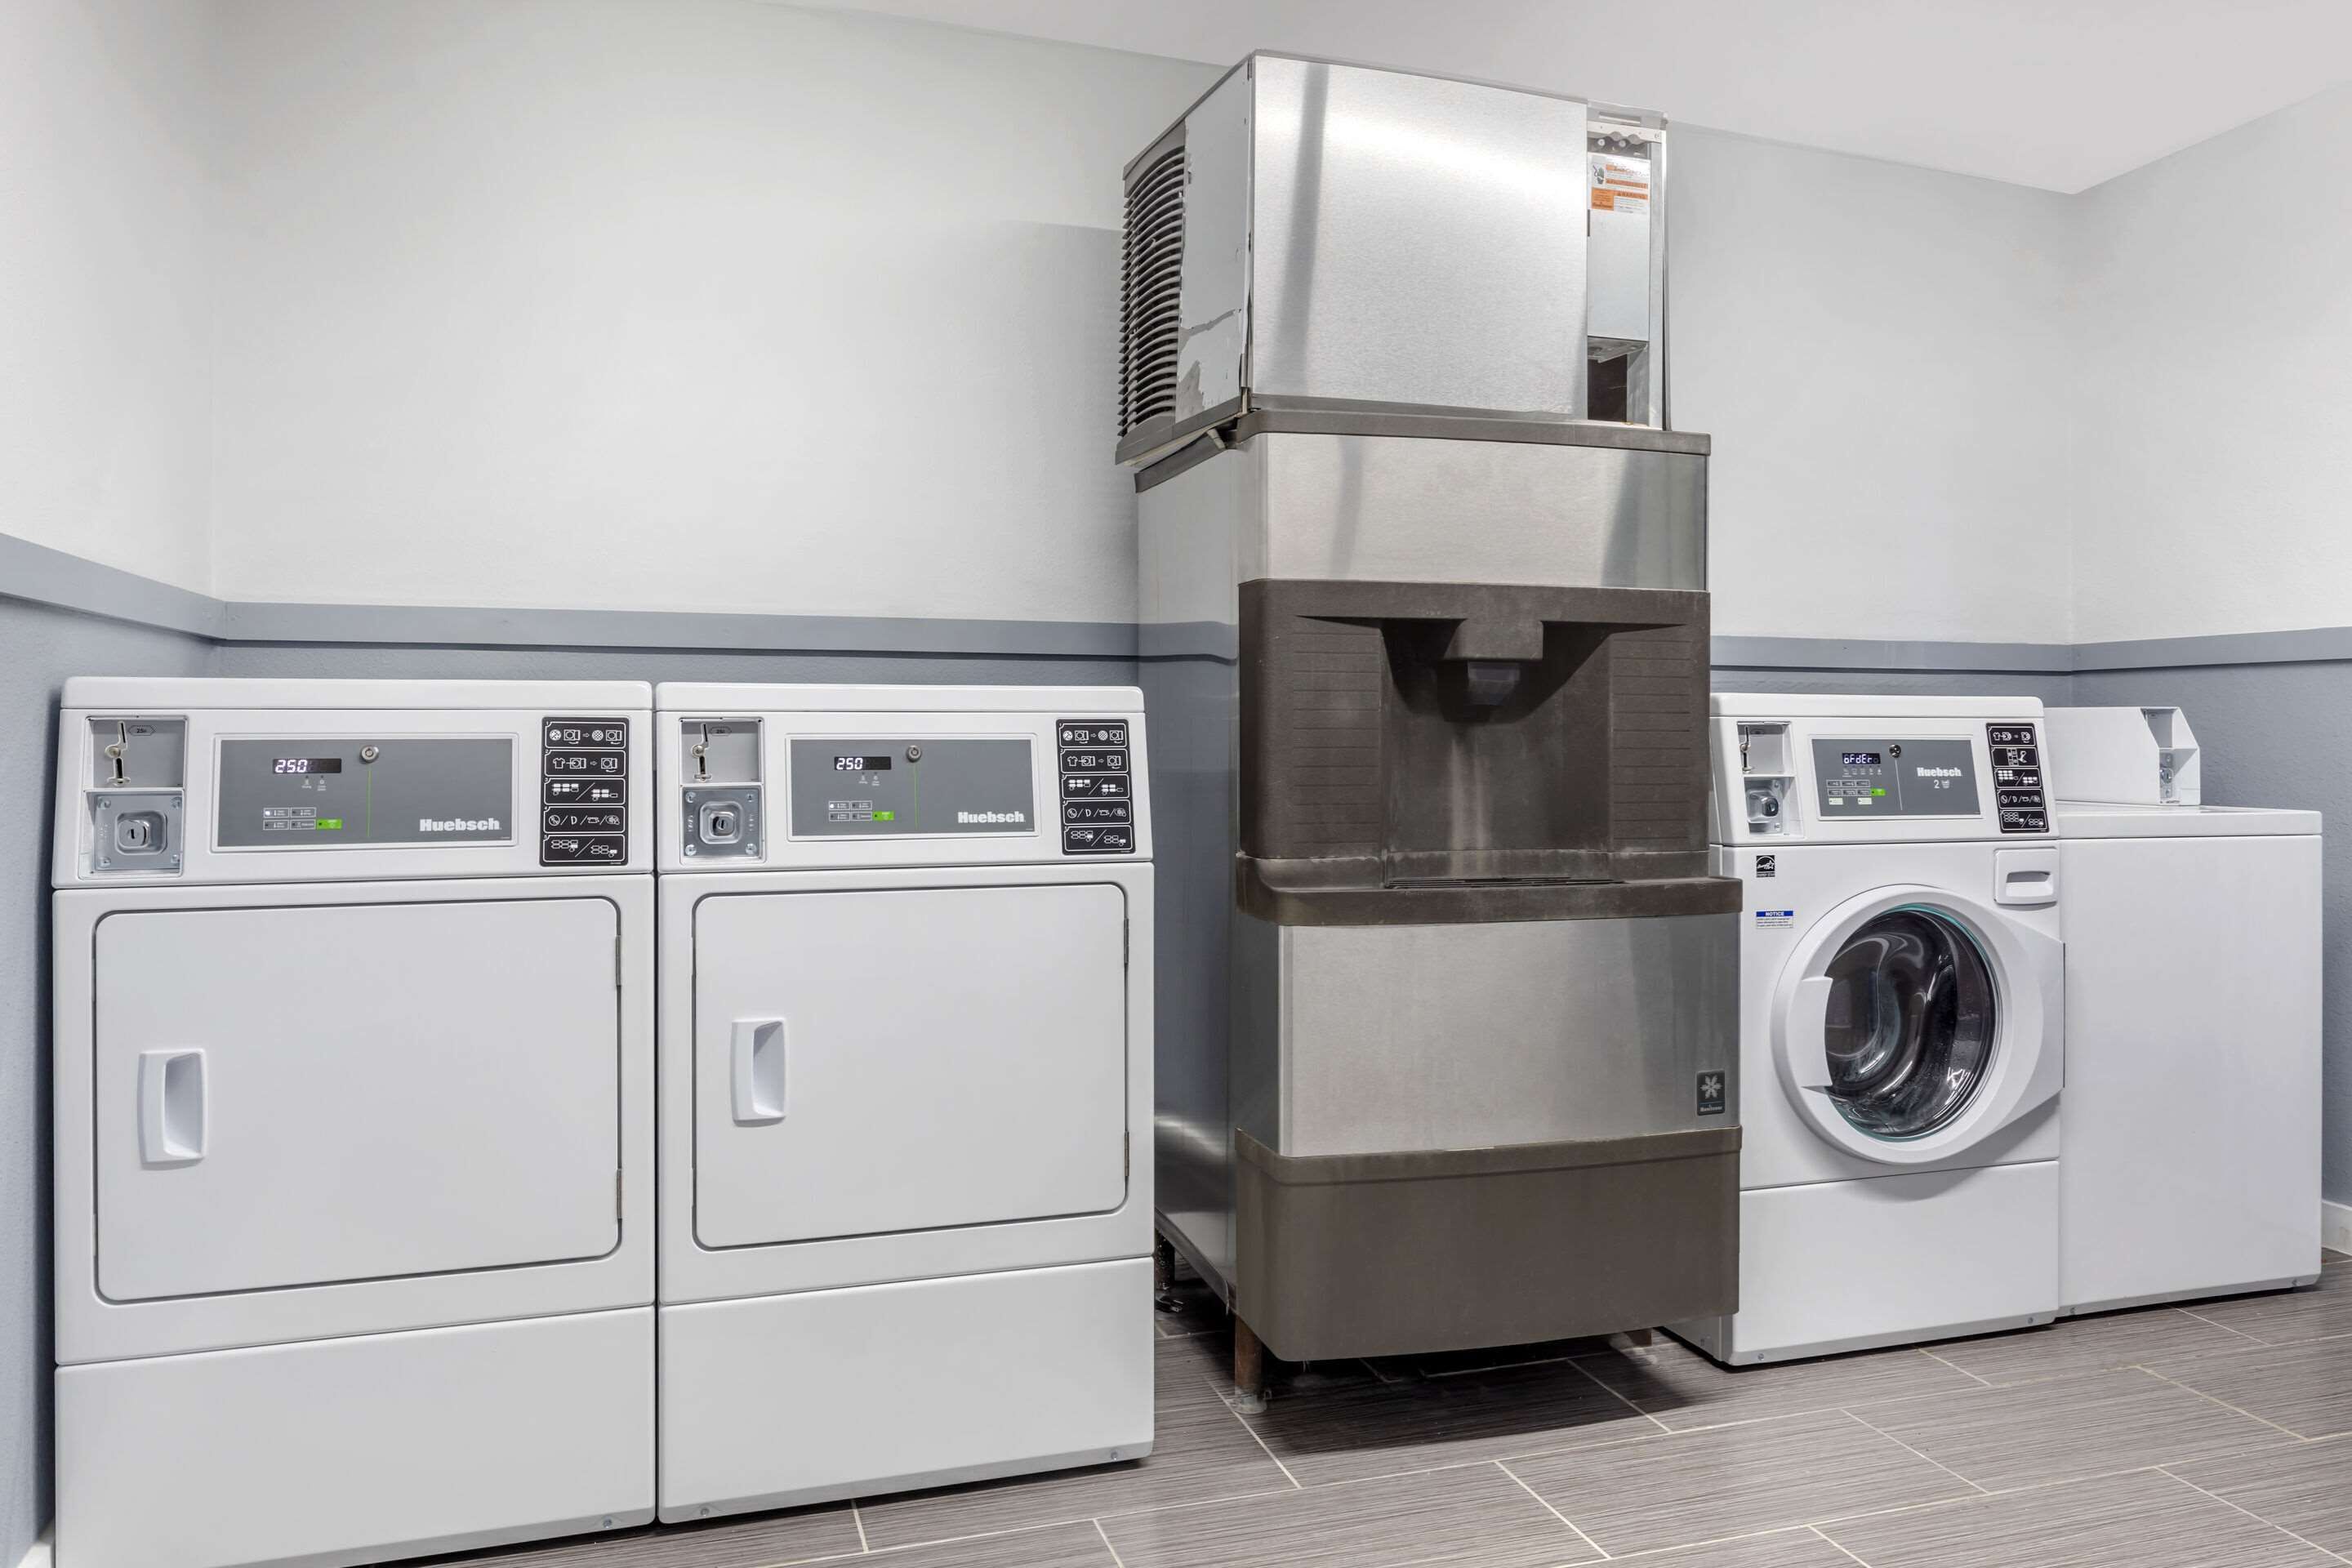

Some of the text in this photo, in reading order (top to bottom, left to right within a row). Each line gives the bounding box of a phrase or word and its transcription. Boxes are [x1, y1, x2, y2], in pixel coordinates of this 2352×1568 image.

[275, 759, 308, 773] 250
[836, 757, 863, 770] 250
[1917, 767, 1962, 777] Huebsch
[1933, 779, 1940, 789] 2
[419, 817, 500, 831] Huebsch
[958, 811, 1025, 824] Huebsch
